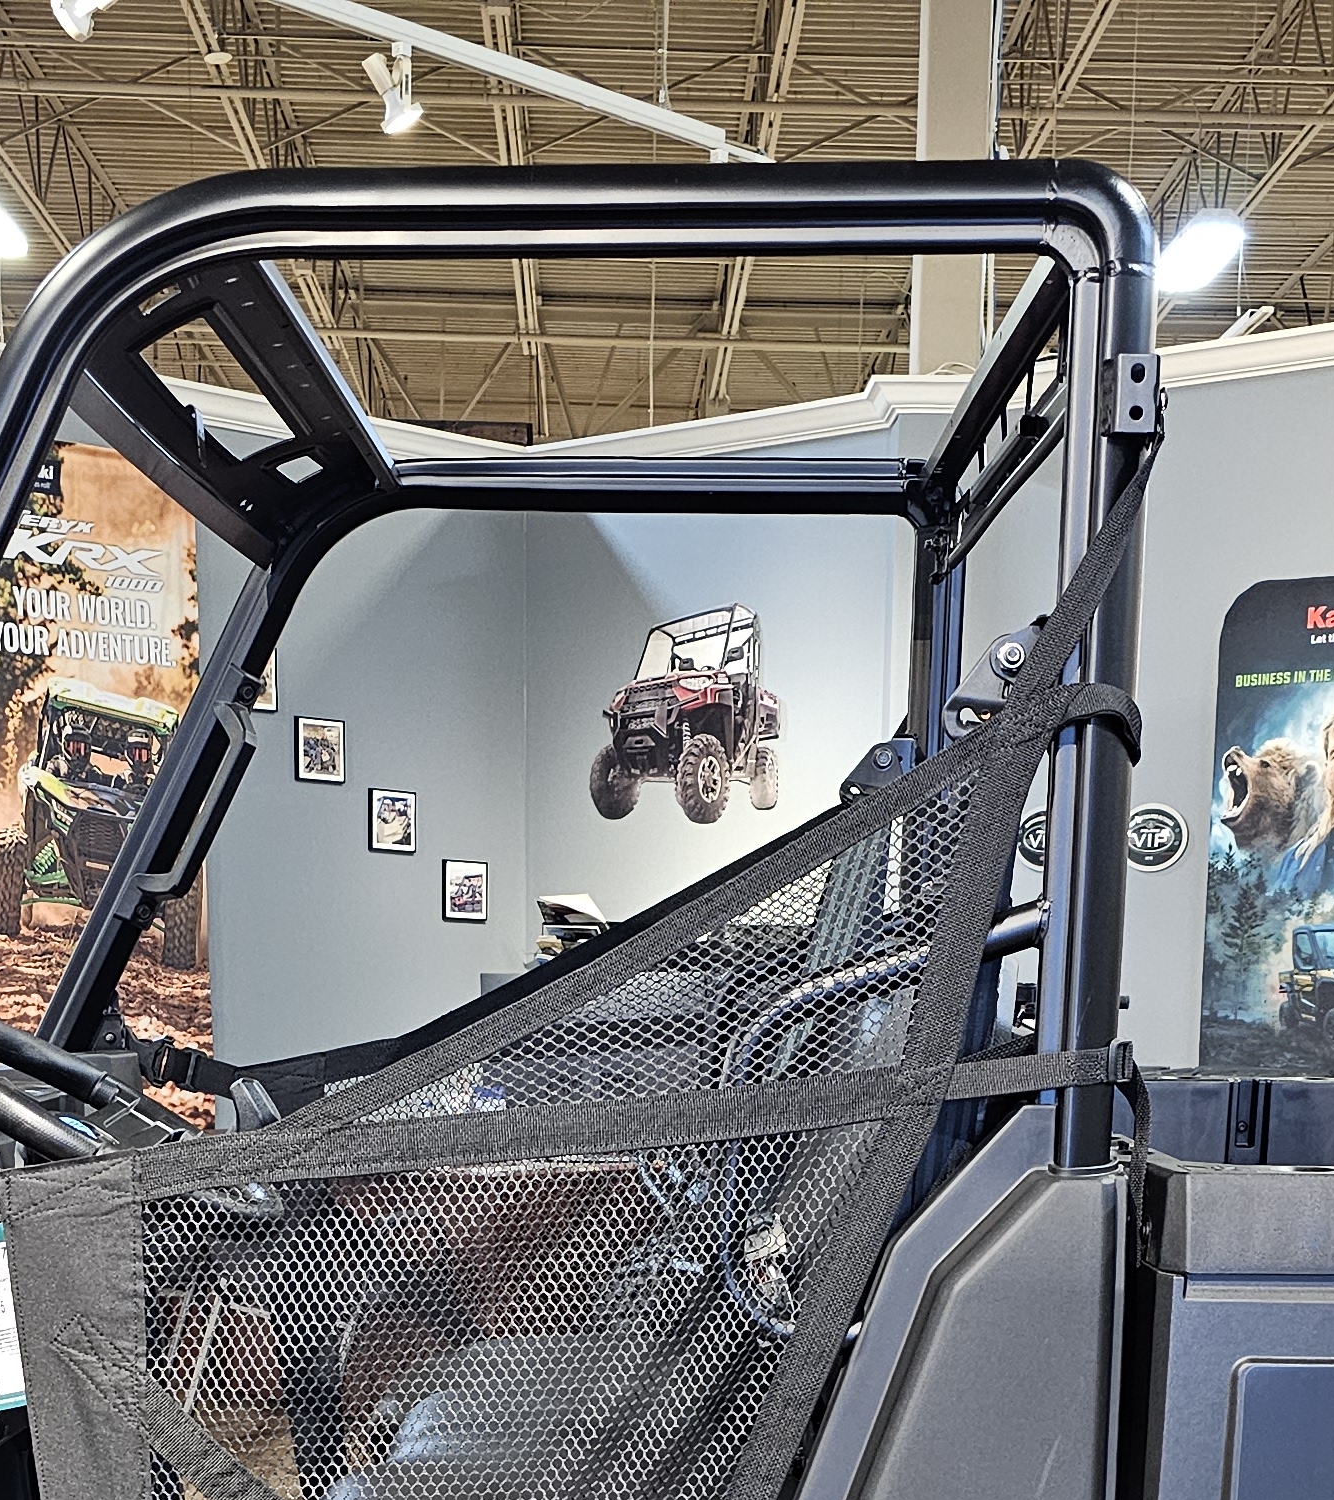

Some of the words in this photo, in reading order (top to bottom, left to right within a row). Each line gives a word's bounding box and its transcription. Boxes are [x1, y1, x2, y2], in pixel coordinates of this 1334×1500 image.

[2, 527, 165, 577] KRX
[104, 574, 165, 593] 1000
[12, 585, 71, 622] YOUR
[78, 593, 157, 630] WORLD.
[56, 627, 177, 668] ADVENTURE.
[1310, 633, 1327, 645] Let
[1235, 670, 1291, 688] BUSINESS
[1293, 669, 1306, 683] IN
[1307, 668, 1331, 682] THE
[1132, 829, 1170, 848] VIP
